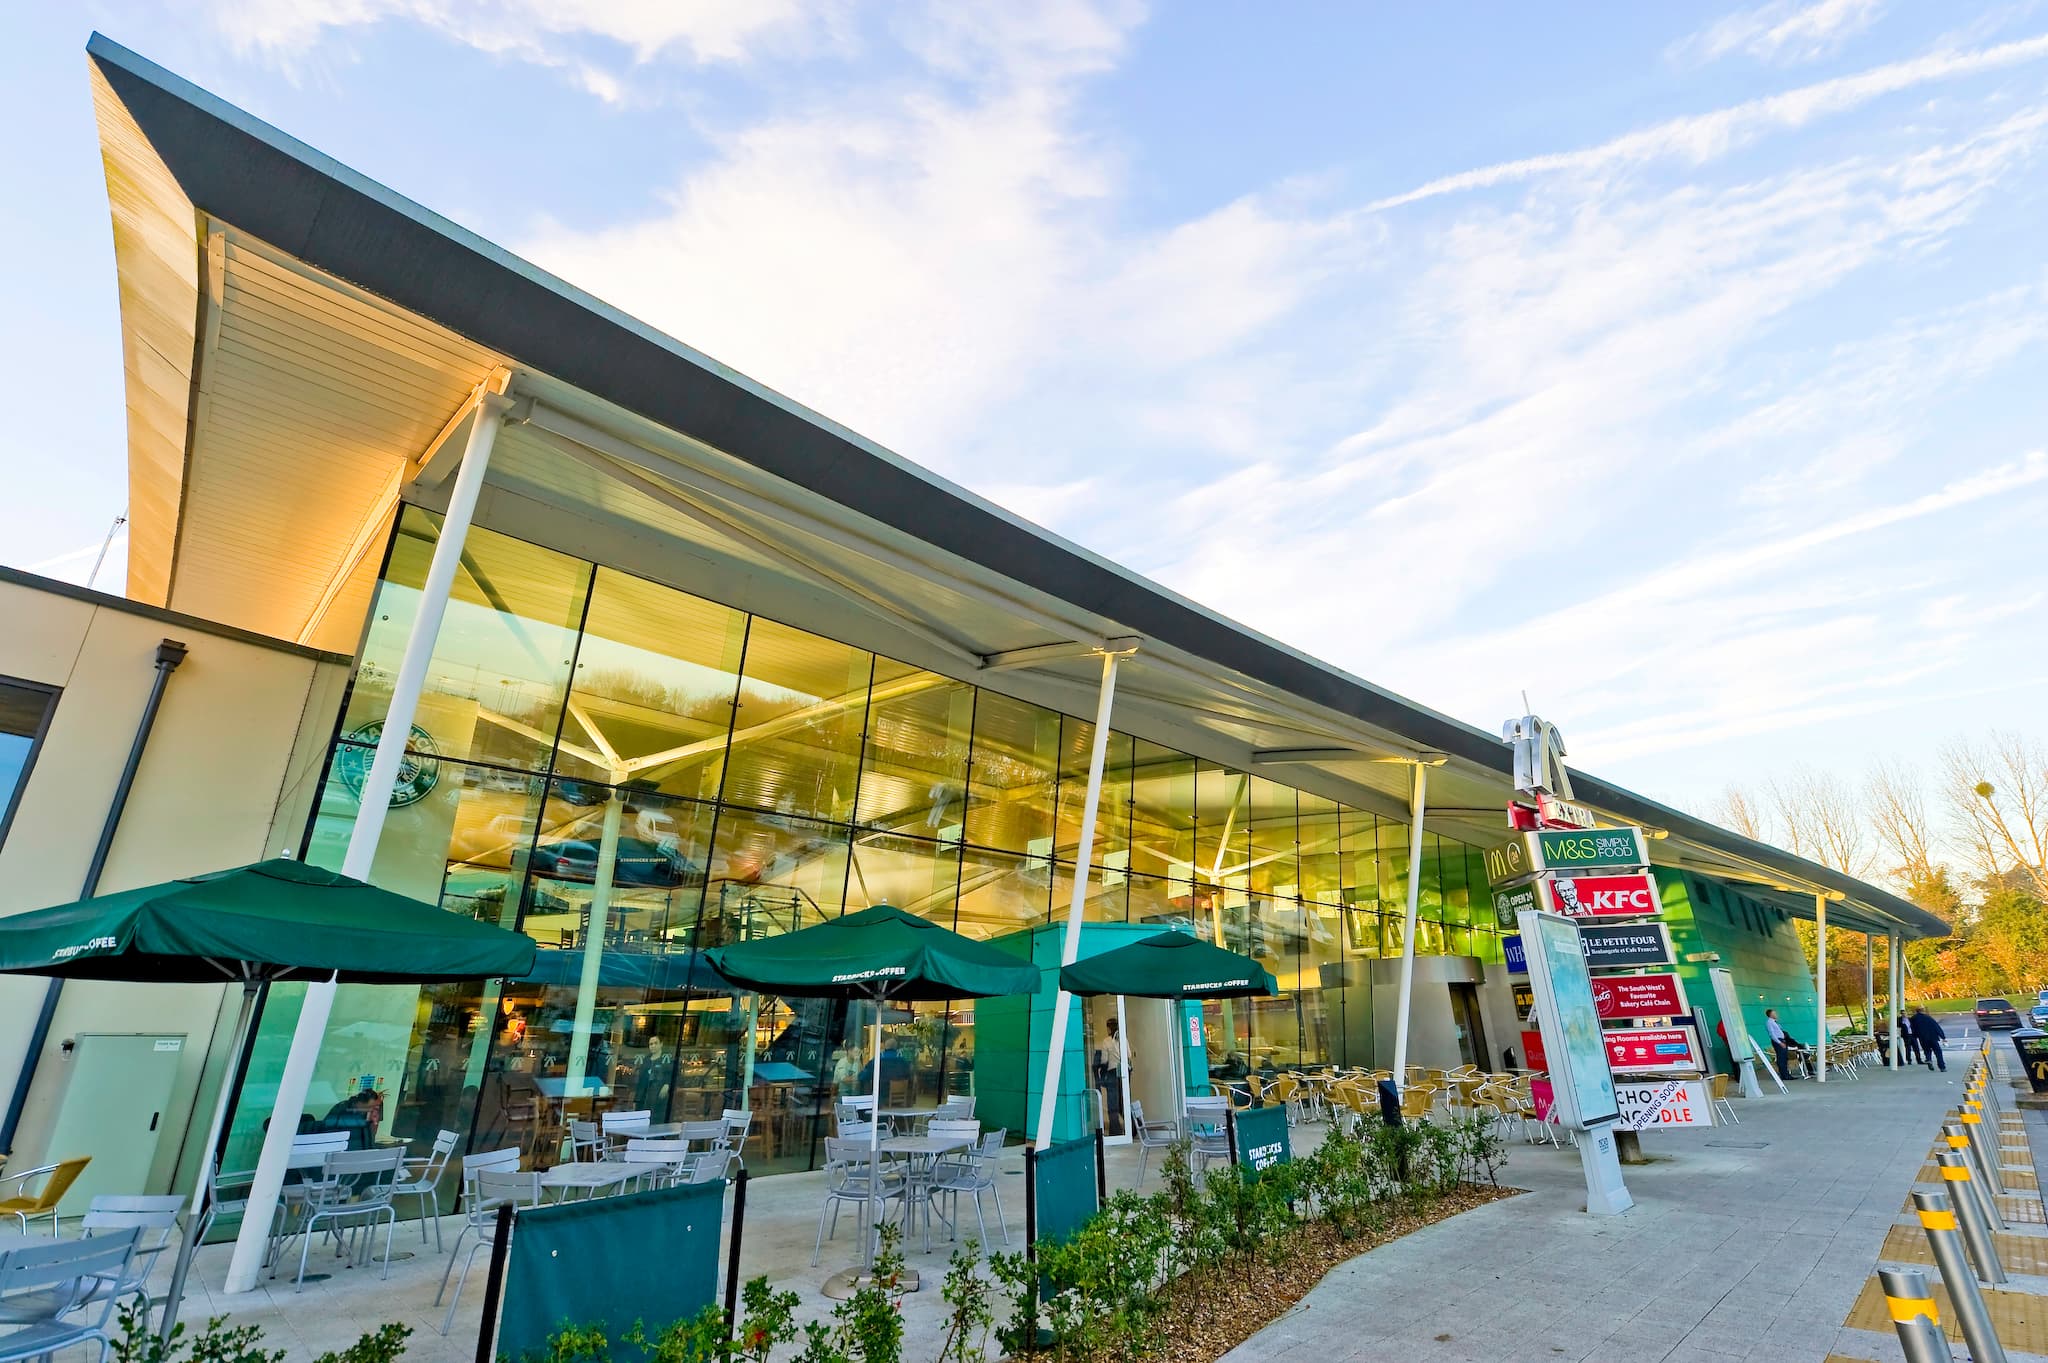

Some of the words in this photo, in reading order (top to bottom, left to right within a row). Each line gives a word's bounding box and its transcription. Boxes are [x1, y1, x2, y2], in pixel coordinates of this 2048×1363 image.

[1596, 837, 1630, 847] SIMPLY
[1544, 838, 1597, 860] M&S
[1598, 846, 1633, 858] FOOD
[1510, 893, 1526, 906] OPEN
[1525, 891, 1534, 902] 24
[1592, 889, 1649, 910] KFC
[1590, 938, 1602, 947] LE
[1603, 937, 1629, 946] PETIT
[1630, 935, 1657, 945] FOUR
[1182, 982, 1222, 991] STARBUCKS
[1629, 984, 1646, 992] South
[1646, 984, 1665, 992] West's
[1620, 1001, 1640, 1009] Bakery
[1639, 1033, 1667, 1041] available
[1616, 1088, 1688, 1105] CHON
[1632, 1099, 1662, 1132] OPENING
[1659, 1079, 1681, 1102] SOON
[1248, 1141, 1283, 1161] STARBCKS
